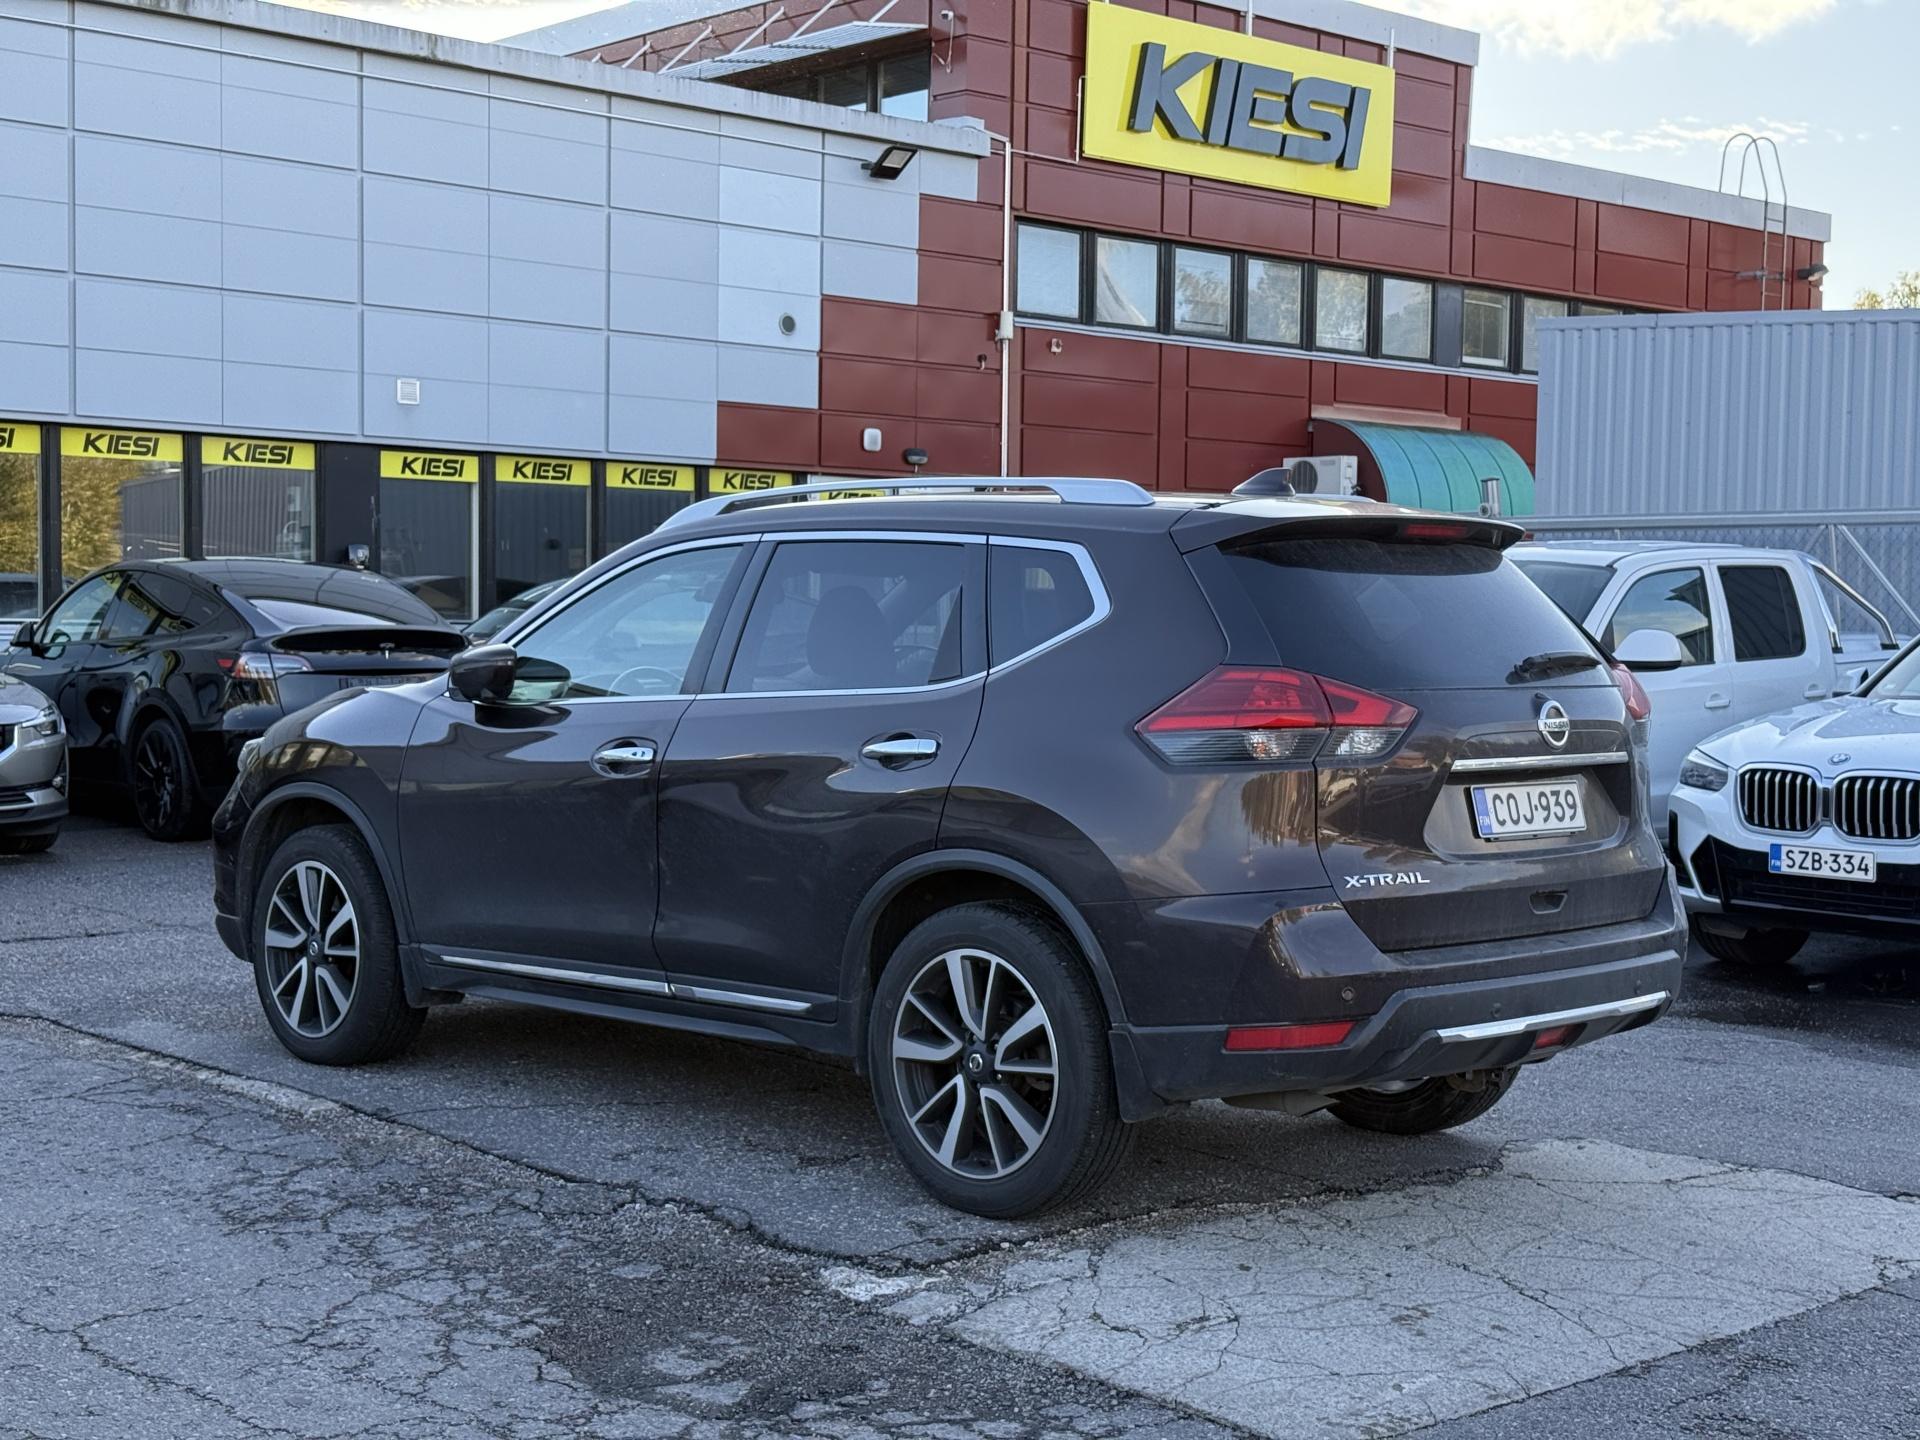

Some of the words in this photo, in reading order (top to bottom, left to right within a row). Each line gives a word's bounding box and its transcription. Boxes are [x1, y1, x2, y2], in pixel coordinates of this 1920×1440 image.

[1128, 42, 1371, 170] KIESI
[83, 433, 160, 457] KIESI
[223, 442, 294, 464] KIESI
[401, 456, 465, 478] KIESI
[513, 461, 572, 481] KIESI
[622, 467, 677, 487] KIESI
[723, 472, 776, 489] KIESI
[1492, 789, 1577, 827] COJ-939
[1786, 850, 1869, 876] SZB-334
[1344, 872, 1431, 889] X-TRAIL
